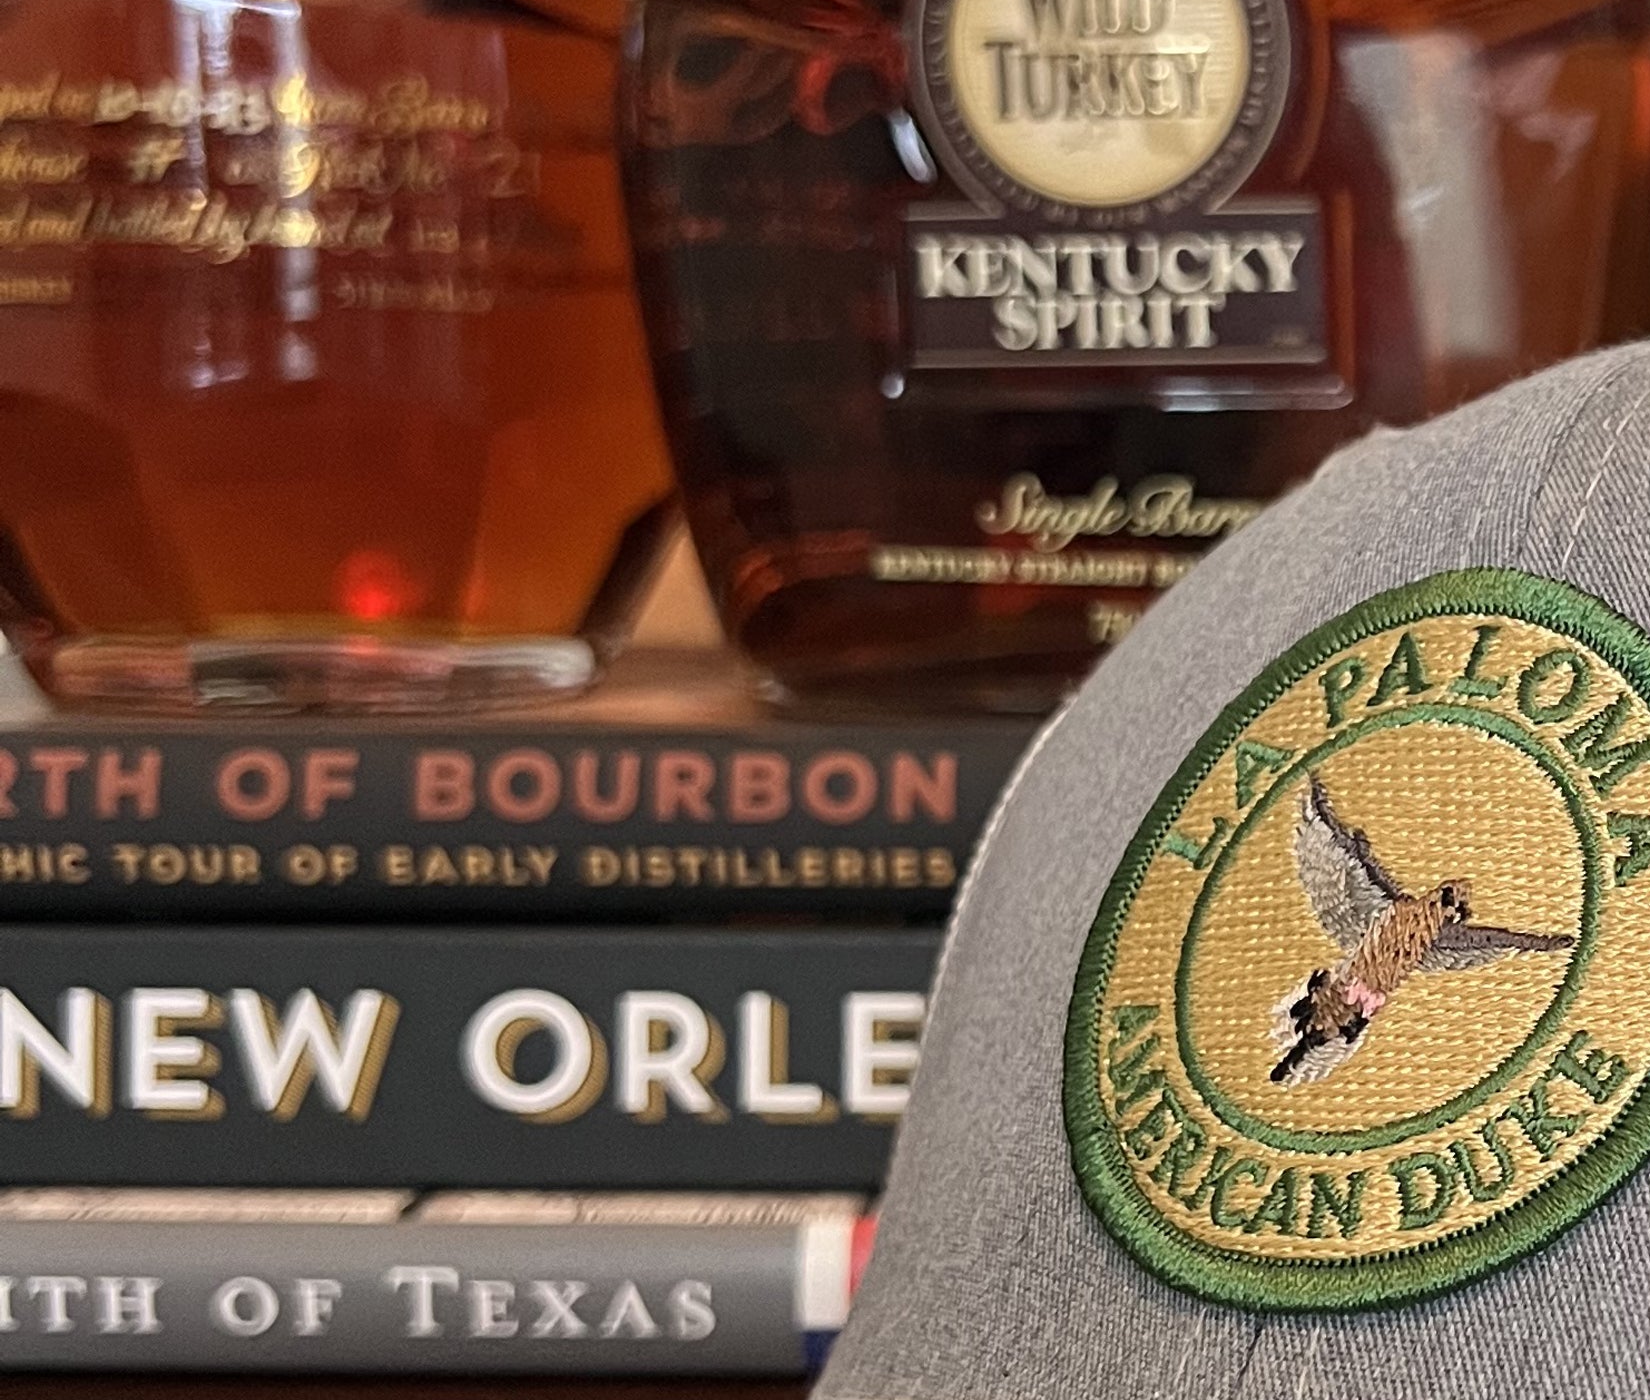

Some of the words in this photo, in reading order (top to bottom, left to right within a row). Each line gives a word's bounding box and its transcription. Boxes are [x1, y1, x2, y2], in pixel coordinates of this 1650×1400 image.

[983, 36, 1212, 122] TURKEY
[915, 231, 1305, 299] KENTUCKY
[992, 290, 1227, 351] SPIRIT
[975, 471, 1131, 553] Single
[215, 747, 361, 822] OF
[411, 749, 959, 825] BOURBON
[1162, 738, 1296, 870] LA
[109, 843, 262, 885] TOUR
[279, 844, 360, 886] OF
[380, 844, 559, 888] EARLY
[580, 846, 957, 889] DISTILLERIES
[0, 987, 401, 1123] NEW
[459, 988, 928, 1124] ORLE
[1105, 1004, 1368, 1240] AMERICAN
[1395, 1029, 1630, 1232] DUKE
[210, 1275, 343, 1337] OF
[385, 1265, 717, 1340] TEXAS
